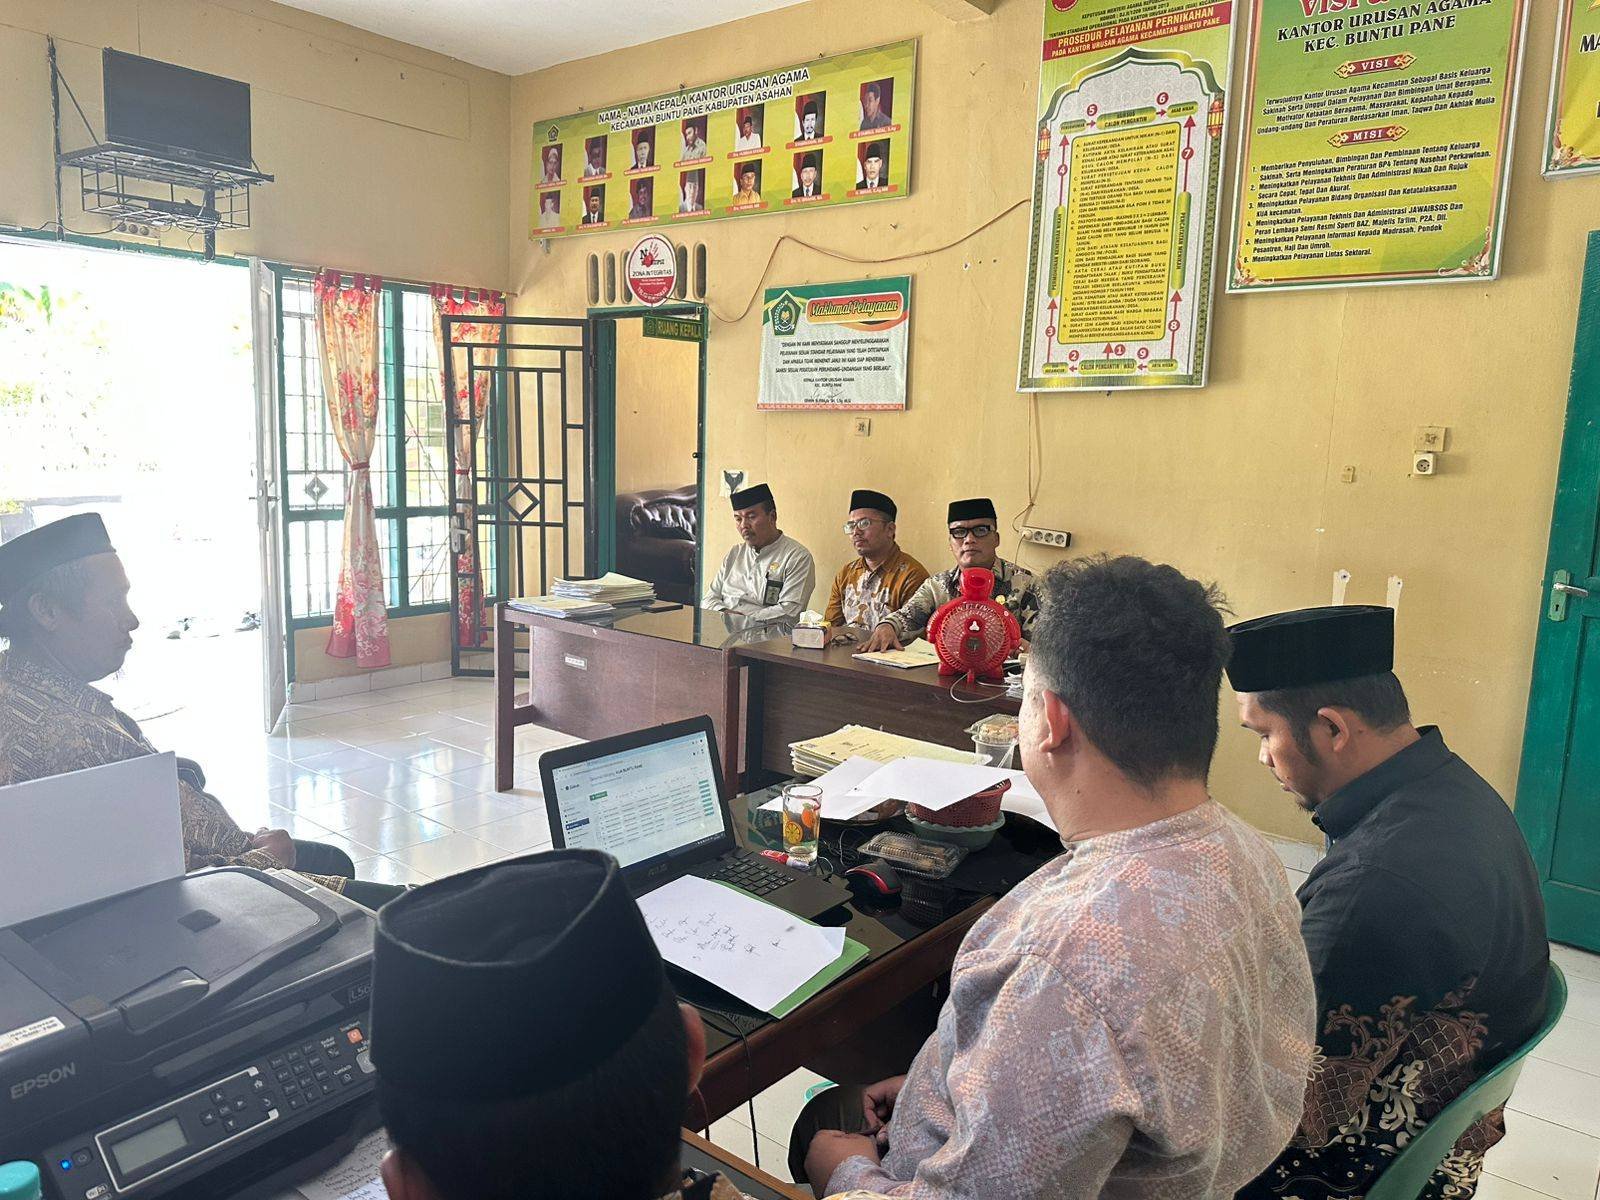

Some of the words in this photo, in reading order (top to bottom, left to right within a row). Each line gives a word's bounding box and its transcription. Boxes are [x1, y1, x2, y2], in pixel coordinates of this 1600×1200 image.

[1058, 30, 1102, 47] PROSEDUR
[1104, 19, 1152, 38] PELAYANAN
[1155, 6, 1213, 27] PERNIKAHAN
[1277, 17, 1343, 40] KANTOR
[1348, 3, 1420, 28] URUSAN
[1304, 35, 1339, 52] KEC.
[1344, 24, 1403, 46] BUNTU
[1409, 15, 1455, 34] PANE
[1051, 48, 1066, 57] PADA
[1067, 43, 1090, 54] KANTOR
[1091, 37, 1116, 49] URUSAN
[1117, 33, 1138, 43] AGAMA
[1140, 24, 1178, 39] KECAMATAN
[1179, 20, 1201, 31] BUNTU
[1203, 16, 1220, 26] PANE
[1361, 58, 1388, 70] VISI
[598, 109, 621, 122] NAMA
[628, 102, 653, 116] NAMA
[654, 94, 687, 110] KEPALA
[689, 86, 726, 103] KANTOR
[729, 77, 768, 94] URUSAN
[771, 68, 808, 86] AGAMA
[1304, 91, 1323, 99] Kantor
[1325, 88, 1347, 96] Urusan
[1349, 84, 1370, 93] Agama
[1372, 79, 1408, 90] Kecamatan
[1439, 72, 1457, 80] Basis
[1459, 67, 1490, 77] Keluarga
[611, 114, 653, 131] KECAMATAN
[655, 109, 680, 122] BUNTU
[682, 104, 703, 116] PANE
[705, 94, 753, 112] KABUPATEN
[755, 85, 792, 102] ASAHAN
[1263, 106, 1285, 115] Sakinah
[1327, 97, 1347, 106] Dalam
[1348, 92, 1381, 103] Pelayanan
[1398, 85, 1433, 96] Bimbingan
[1410, 93, 1445, 104] Kepatuhan
[1448, 89, 1473, 99] Kepada
[1317, 116, 1347, 126] Peraturan
[1349, 110, 1389, 122] Berdasarkan
[1412, 104, 1432, 113] Taqwa
[1352, 129, 1382, 140] MISI
[1260, 161, 1296, 171] Memberikan
[1335, 153, 1368, 163] Bimbingan
[1384, 147, 1420, 157] Pembinaan
[1422, 144, 1447, 153] Tentang
[1449, 141, 1480, 150] Keluarga
[1302, 166, 1344, 176] Meningkatkan
[1346, 162, 1376, 172] Peraturan
[1393, 158, 1417, 167] Tentang
[1420, 154, 1446, 164] Nasehat
[1258, 180, 1298, 190] Meningkatkan
[1300, 176, 1331, 186] Pelayanan
[1333, 174, 1355, 182] Tekhnis
[1371, 168, 1411, 178] Administrasi
[1413, 166, 1431, 174] Nikah
[1448, 162, 1467, 170] Rujuk
[1257, 198, 1296, 208] Meningkatkan
[1299, 195, 1329, 204] Pelayanan
[1330, 193, 1352, 201] Bidang
[1353, 190, 1386, 199] Organisasi
[1258, 191, 1277, 199] Secara
[1255, 217, 1295, 226] Meningkatkan
[1296, 214, 1327, 223] Pelayanan
[1329, 212, 1351, 220] Tekhnis
[1367, 207, 1406, 217] Administrasi
[1254, 235, 1293, 244] Meningkatkan
[1295, 233, 1325, 241] Pelayanan
[1327, 230, 1355, 239] Informasi
[1357, 228, 1380, 236] Kepada
[1418, 223, 1442, 232] Pondok
[1272, 225, 1298, 234] Lembaga
[1252, 253, 1291, 262] Meningkatkan
[1293, 251, 1323, 259] Pelayanan
[10, 1061, 76, 1099] EPSON
